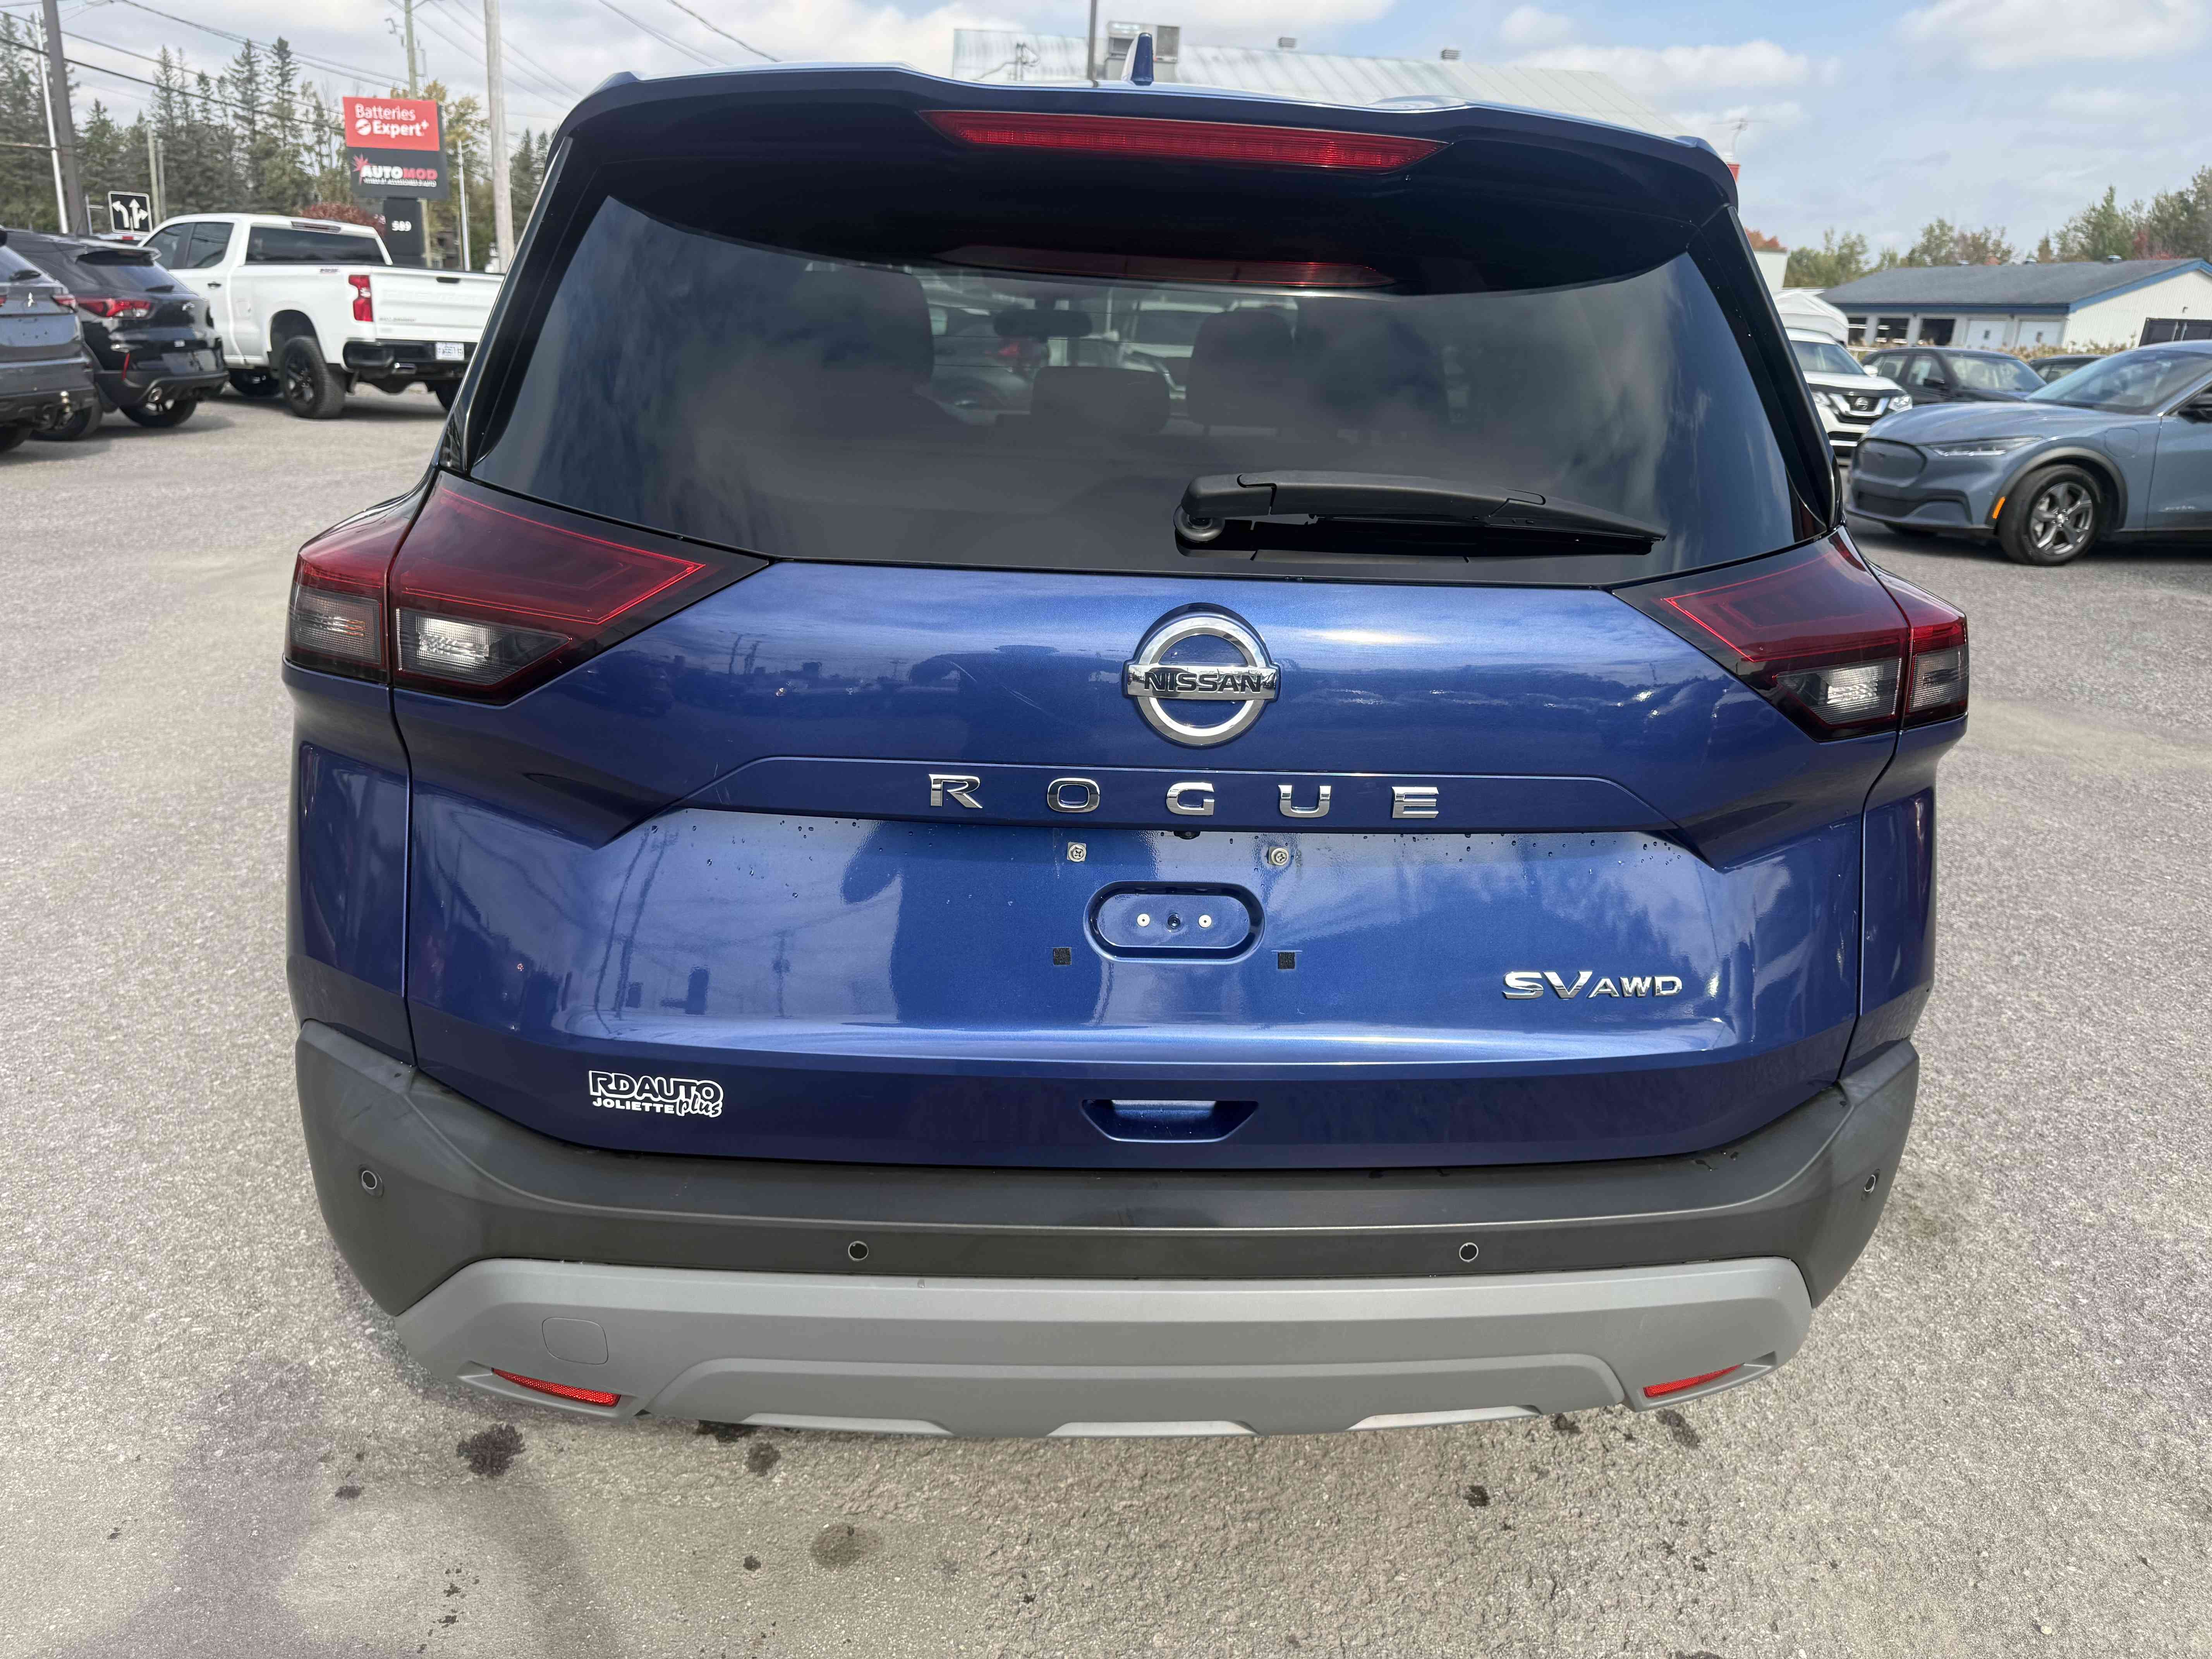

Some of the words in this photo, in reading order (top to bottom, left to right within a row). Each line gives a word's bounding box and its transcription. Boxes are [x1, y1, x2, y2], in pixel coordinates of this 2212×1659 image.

[355, 103, 416, 121] Batteries
[360, 165, 438, 180] AUTOMOD
[1144, 672, 1261, 694] NISSAN
[929, 773, 1440, 819] ROGUE
[1502, 970, 1592, 1000] SV
[1587, 975, 1683, 998] AWD
[592, 1097, 675, 1114] JOLIETTE
[676, 1093, 723, 1118] plus
